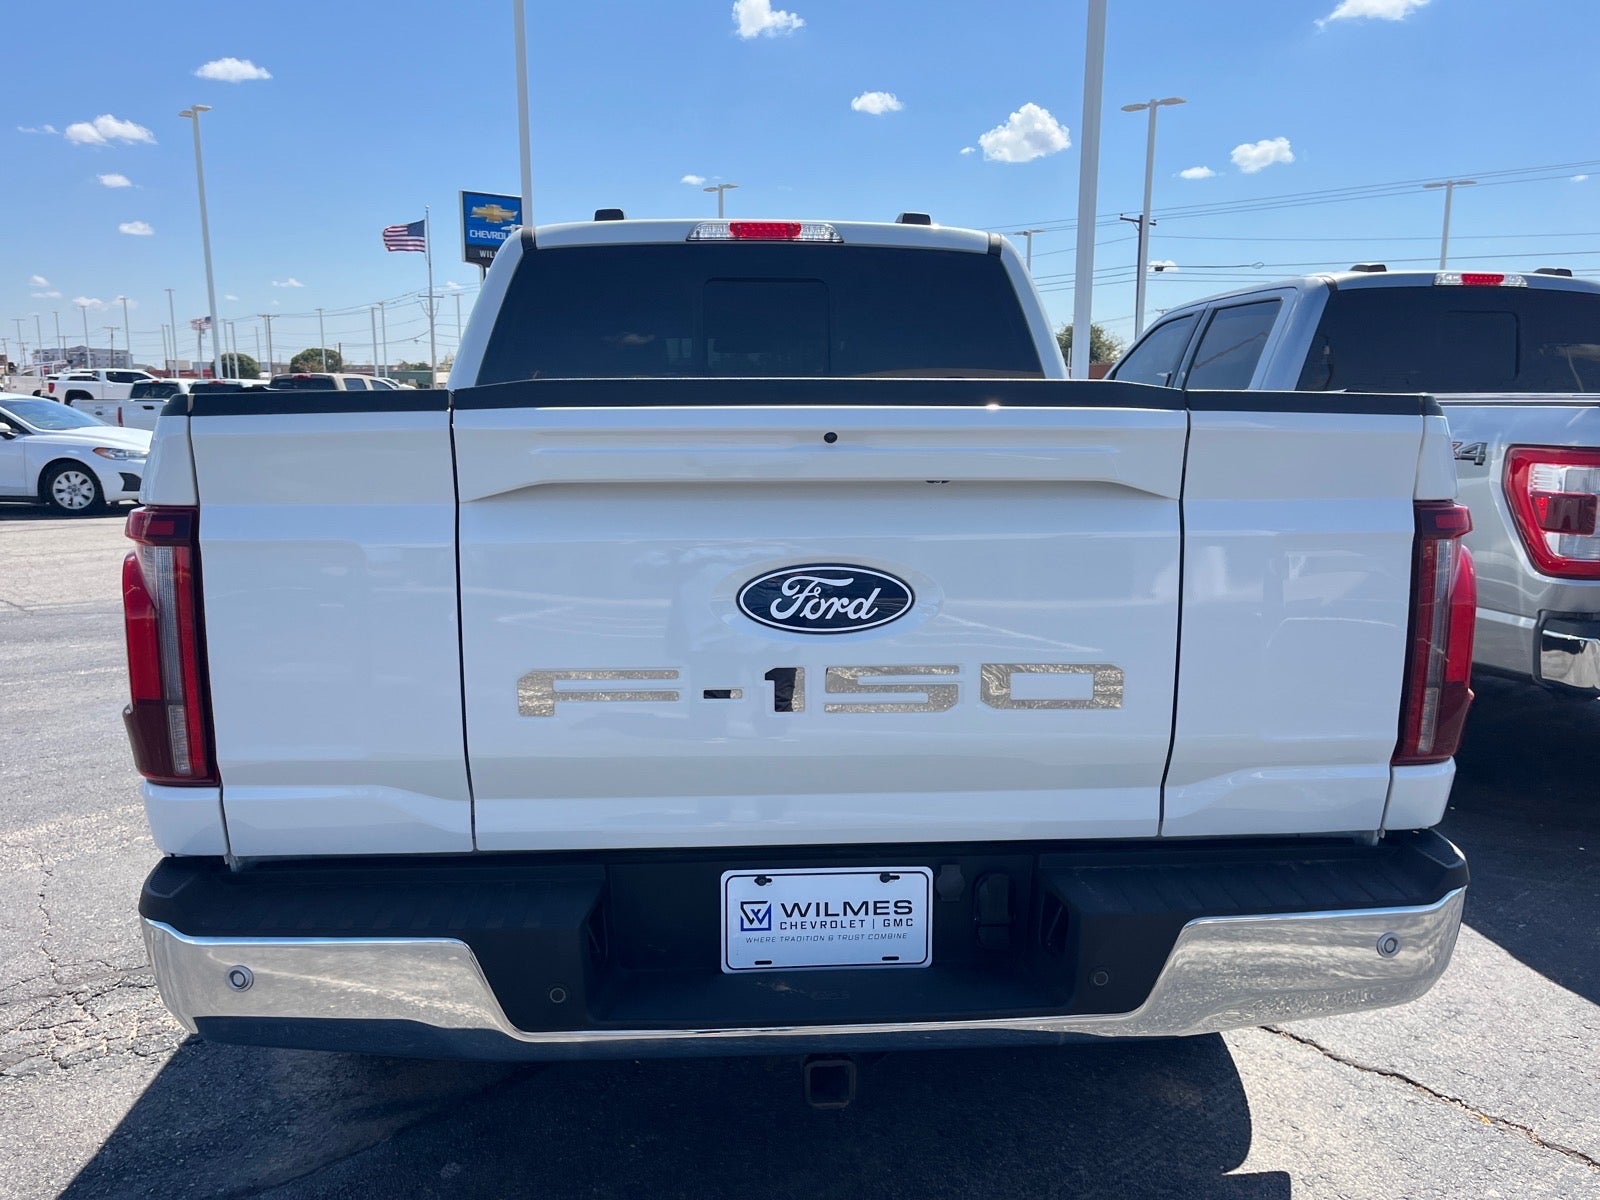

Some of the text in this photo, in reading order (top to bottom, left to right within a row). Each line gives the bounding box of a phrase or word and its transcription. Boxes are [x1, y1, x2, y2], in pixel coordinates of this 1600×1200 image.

[469, 229, 510, 240] CHEVROL
[479, 250, 498, 259] WIL
[769, 574, 879, 621] Ford
[516, 663, 1125, 717] F-150
[780, 900, 913, 918] WILMES
[779, 918, 913, 930] CHEVROLET GMC
